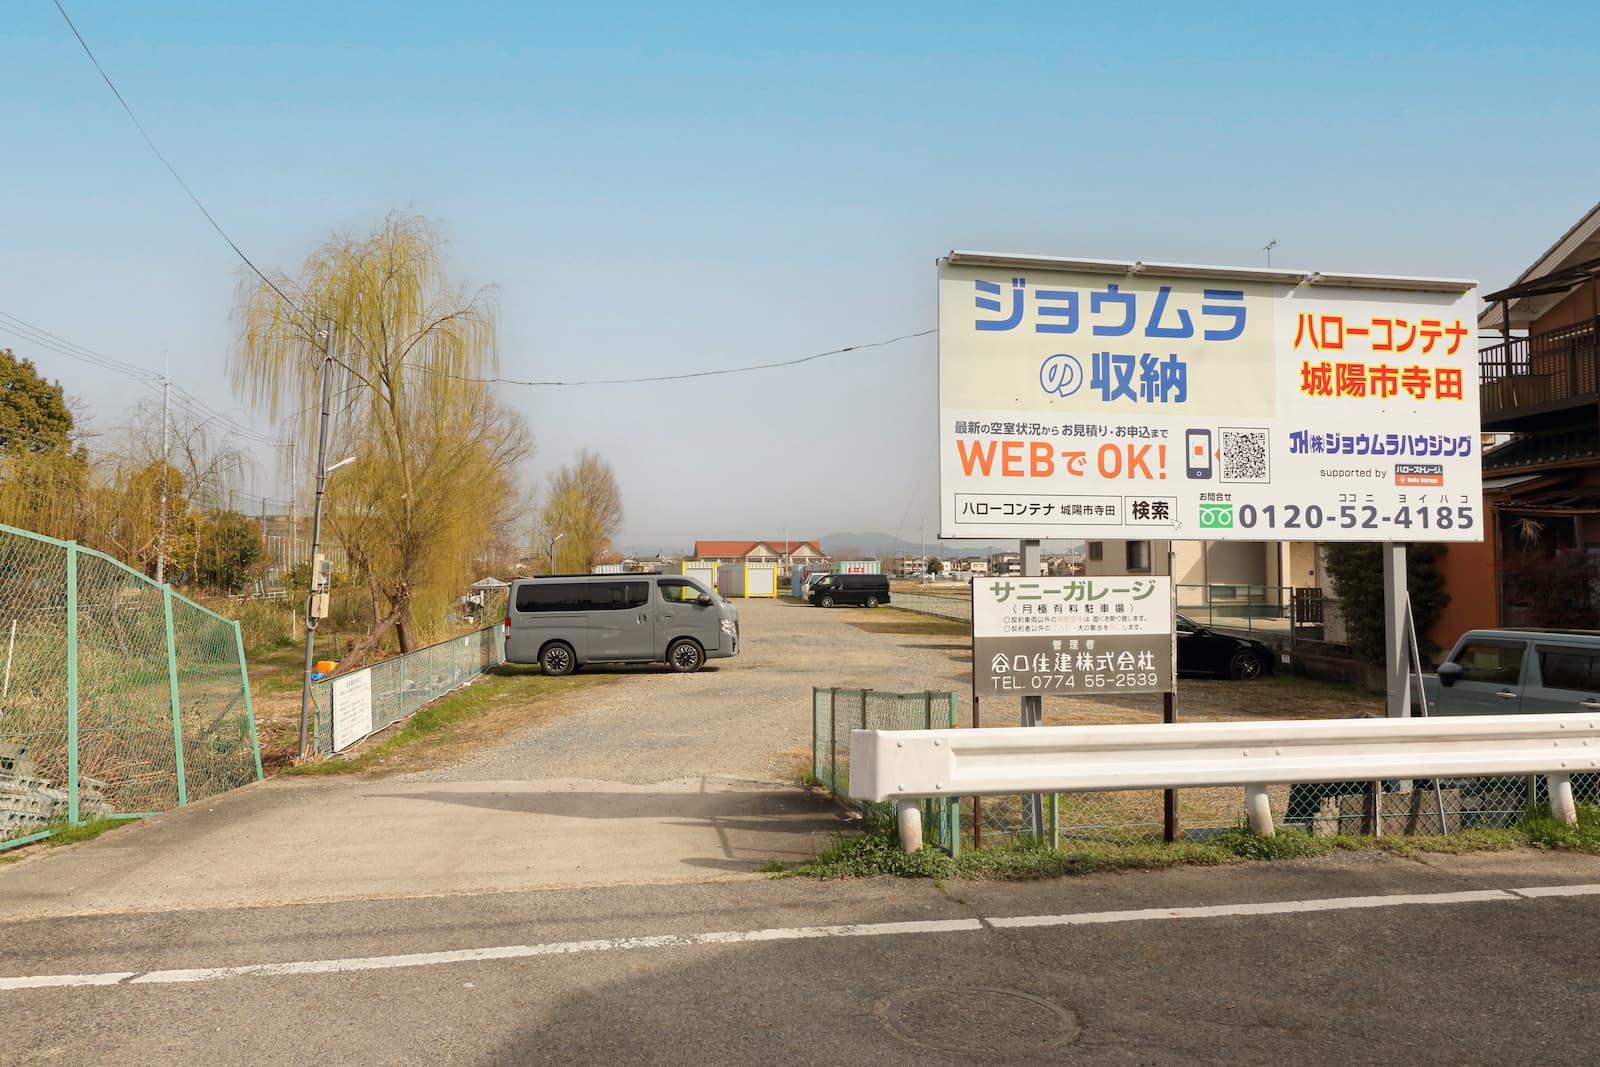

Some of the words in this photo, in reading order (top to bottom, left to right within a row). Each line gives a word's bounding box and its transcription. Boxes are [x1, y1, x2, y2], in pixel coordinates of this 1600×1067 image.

[975, 277, 1247, 341] ジョウムラ
[1294, 312, 1469, 356] ハローコンテナ
[1040, 351, 1187, 403] の収納
[1300, 360, 1463, 400] 城陽市寺田
[1320, 468, 1372, 478] supported
[1375, 468, 1387, 479] by
[1396, 466, 1440, 474] ハローストレージ
[1199, 492, 1232, 502] お問合せ
[962, 502, 1055, 516] ハローコンテナ
[1060, 504, 1116, 516] 城陽市寺田
[1132, 500, 1169, 520] 検索
[1238, 503, 1474, 530] 0120-52-4185
[990, 579, 1156, 603] サニーガレージ
[991, 650, 1156, 673] 谷口住建株式会社
[991, 676, 1026, 690] TEL.
[1031, 675, 1076, 689] 0774
[1084, 672, 1158, 688] 55-2539
